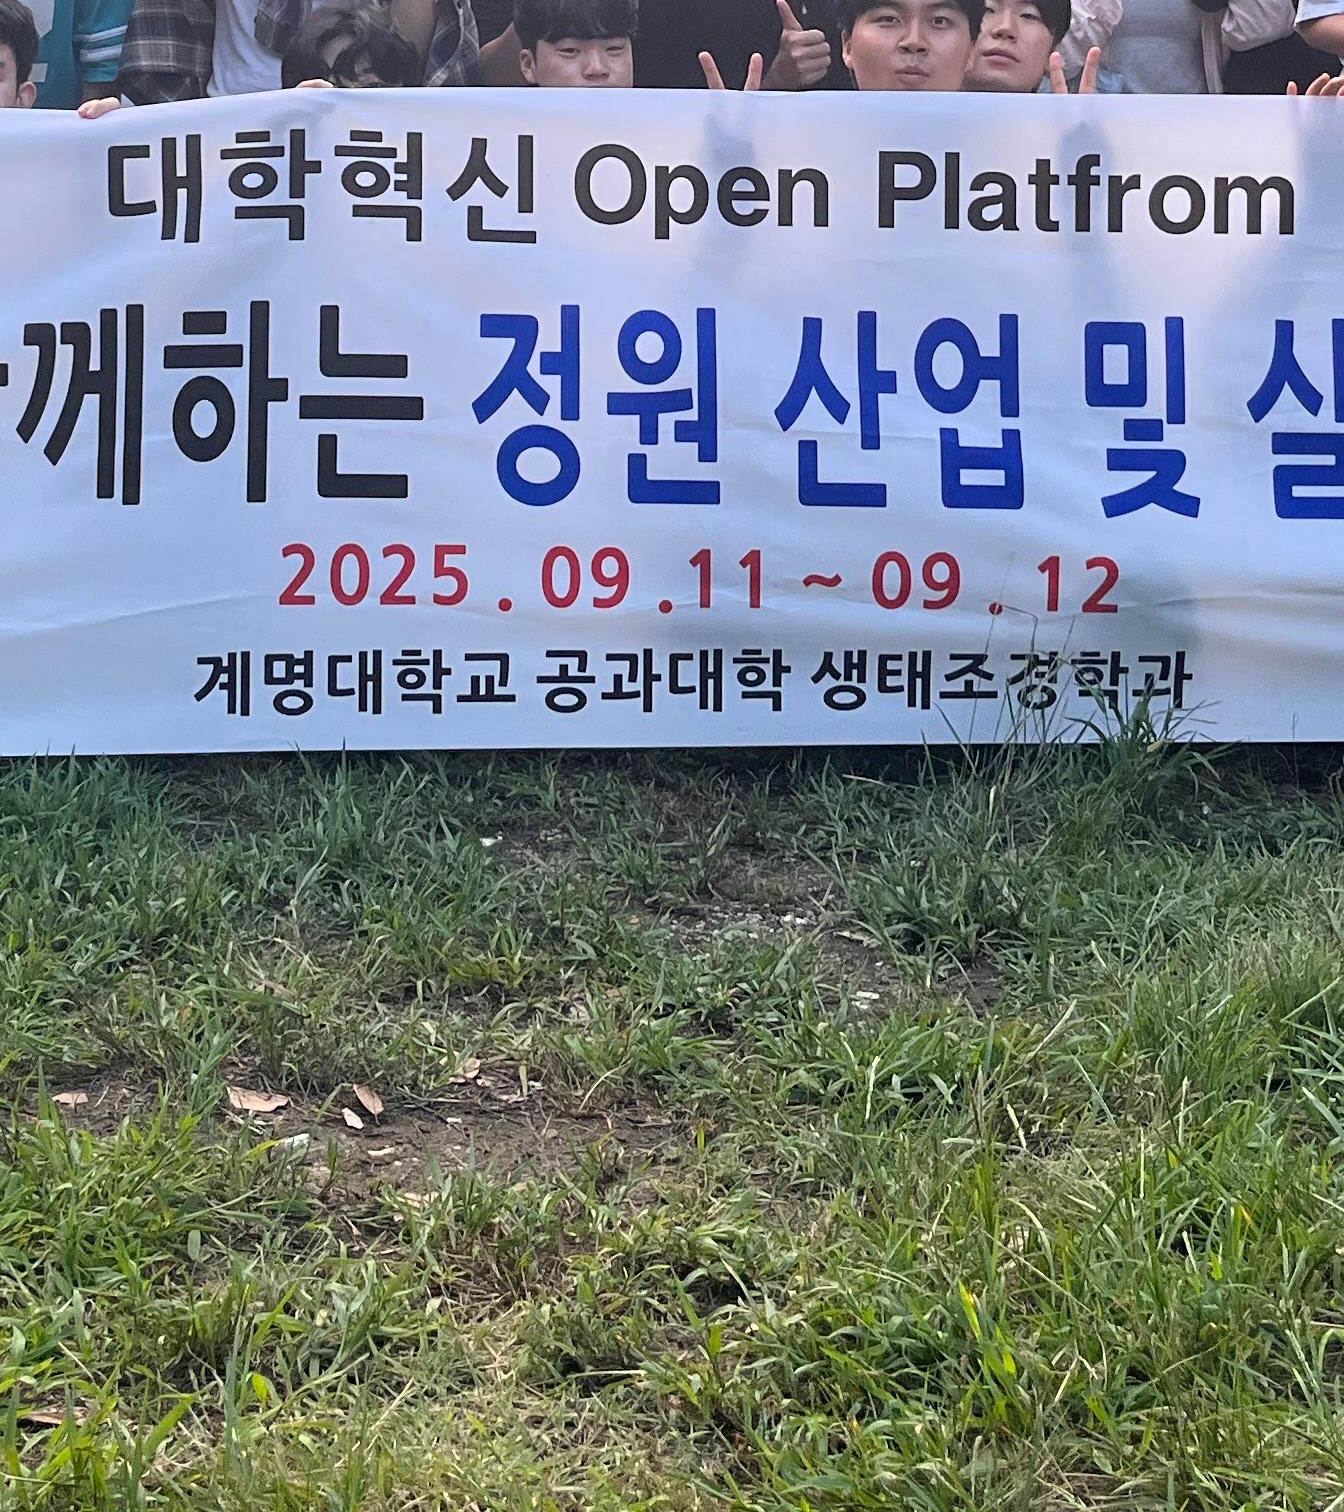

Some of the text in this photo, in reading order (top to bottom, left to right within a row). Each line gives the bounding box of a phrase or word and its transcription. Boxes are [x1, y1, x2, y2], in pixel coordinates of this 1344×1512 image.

[107, 128, 1296, 245] 대학혁신 Open Platfrom
[471, 304, 721, 507] 정원
[773, 310, 1025, 510] 산업
[1084, 316, 1201, 520] 및
[193, 647, 1194, 717] 계명대학교 공과대학 생태조경학과
